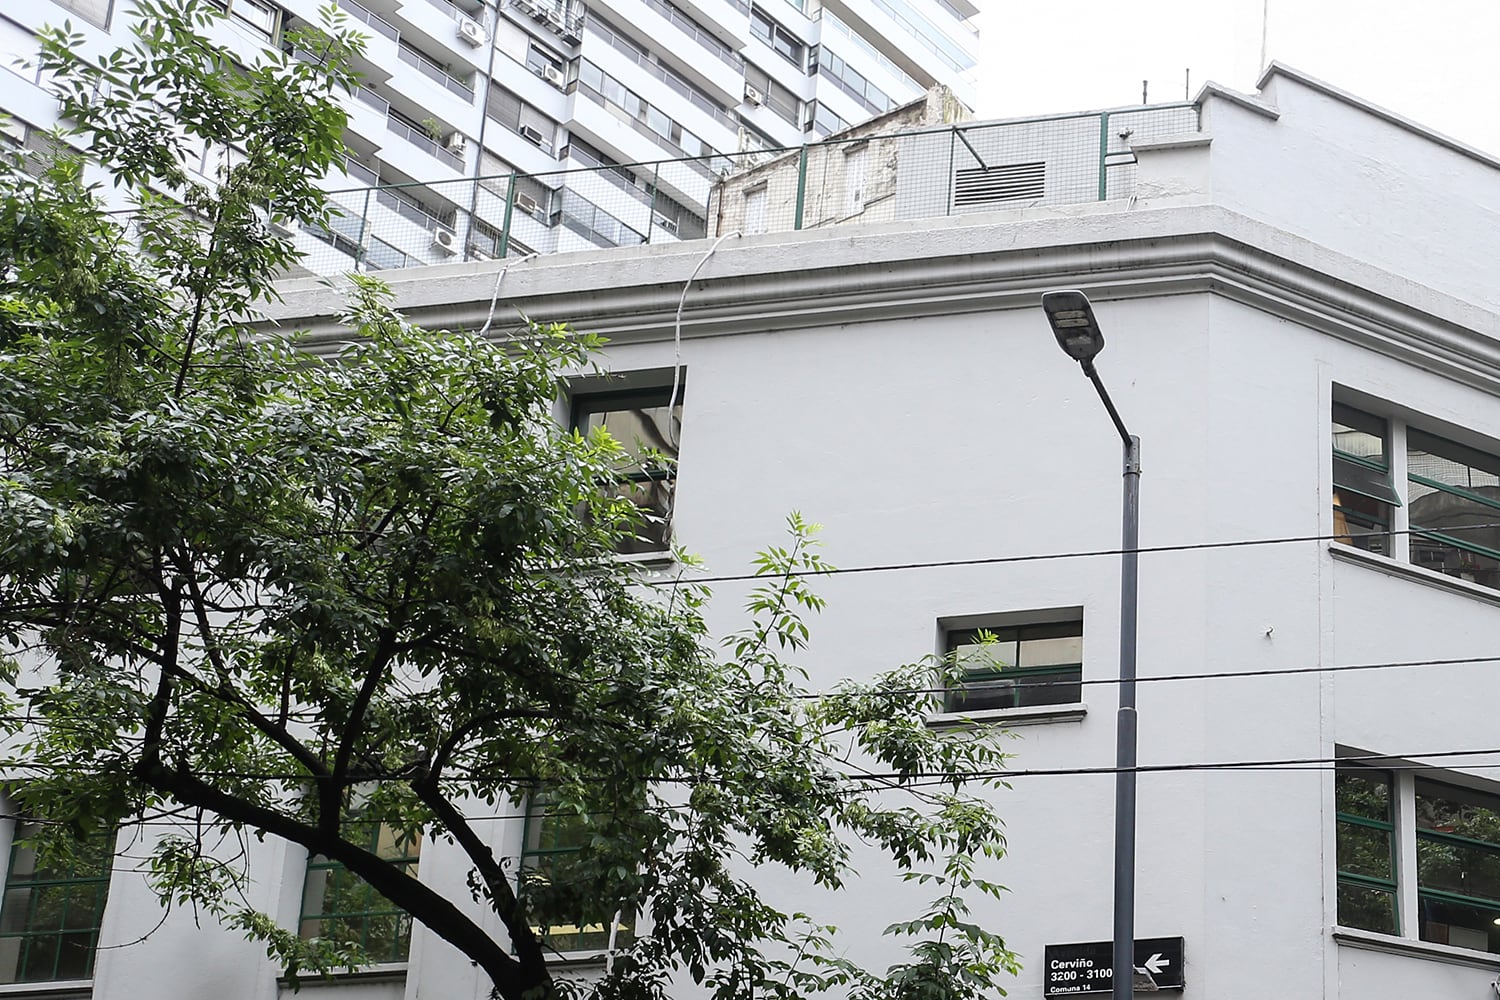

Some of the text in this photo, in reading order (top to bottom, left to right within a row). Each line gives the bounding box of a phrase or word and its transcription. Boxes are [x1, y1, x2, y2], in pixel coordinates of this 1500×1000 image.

[1050, 958, 1094, 970] Cerviño
[1050, 970, 1077, 982] 3200
[1086, 967, 1113, 980] 3100
[1050, 983, 1091, 993] Comuna 14
